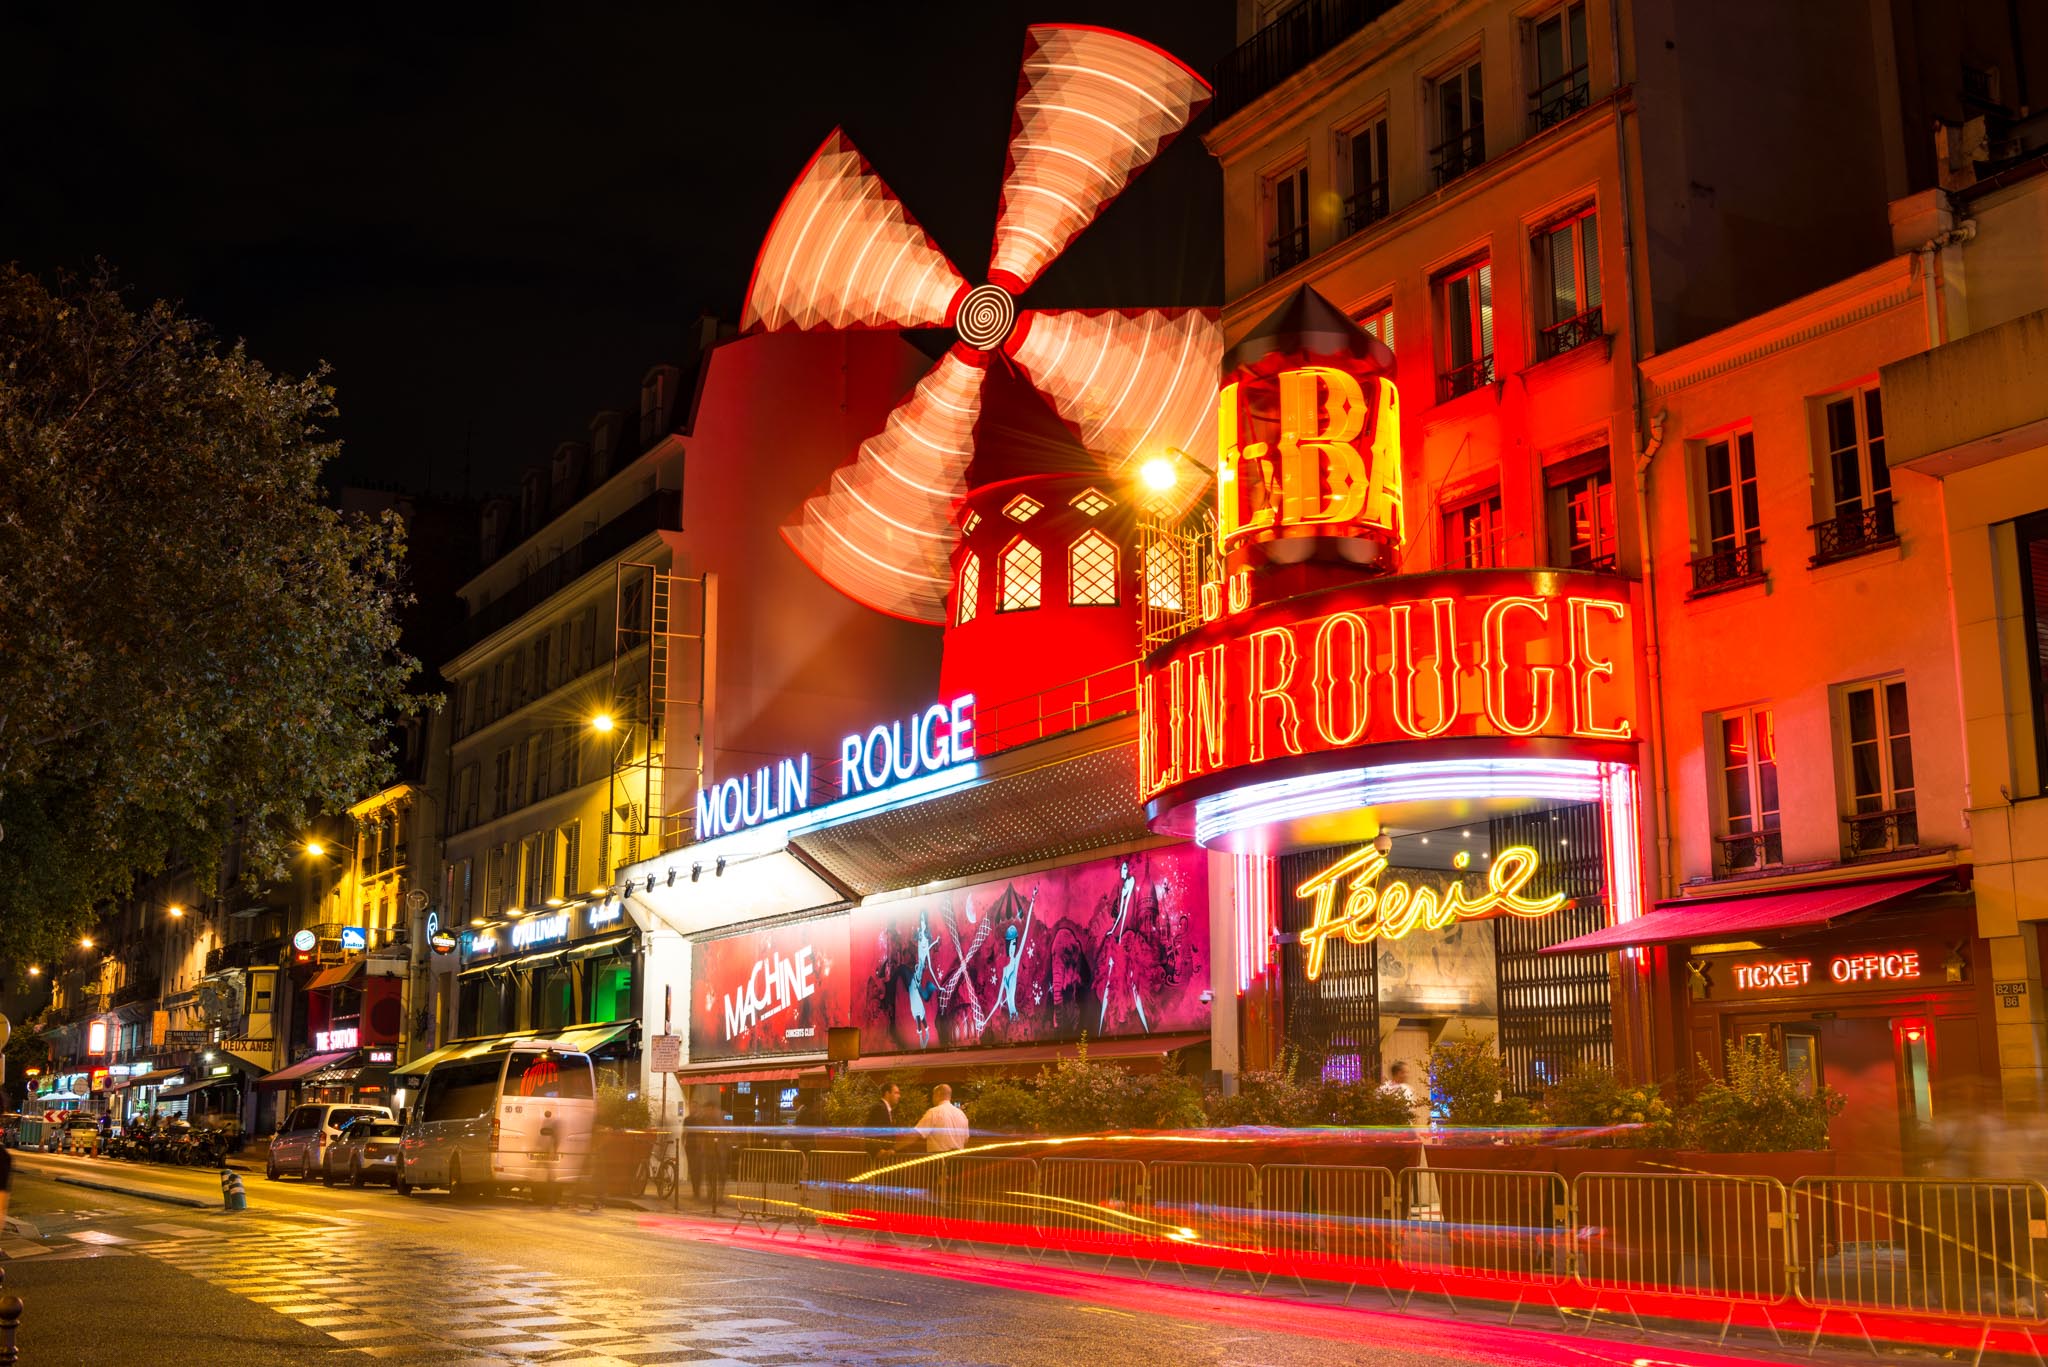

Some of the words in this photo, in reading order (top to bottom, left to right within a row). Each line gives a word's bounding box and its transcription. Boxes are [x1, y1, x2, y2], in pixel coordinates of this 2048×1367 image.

[1201, 571, 1249, 622] DU
[1139, 644, 1225, 804] LIN
[1249, 597, 1632, 762] ROUGE
[695, 752, 810, 840] MOULIN
[841, 693, 975, 795] ROUGE
[1296, 843, 1567, 981] Féerie
[1733, 961, 1811, 989] TICKET
[1831, 952, 1921, 983] OFFICE
[1997, 985, 2009, 994] 82
[2012, 984, 2024, 993] 84
[724, 944, 815, 1041] MACHINE
[2005, 997, 2018, 1007] 86
[224, 1041, 248, 1051] DEUX
[316, 1031, 330, 1051] THE
[330, 1027, 359, 1050] STATION
[370, 1052, 392, 1061] BAR
